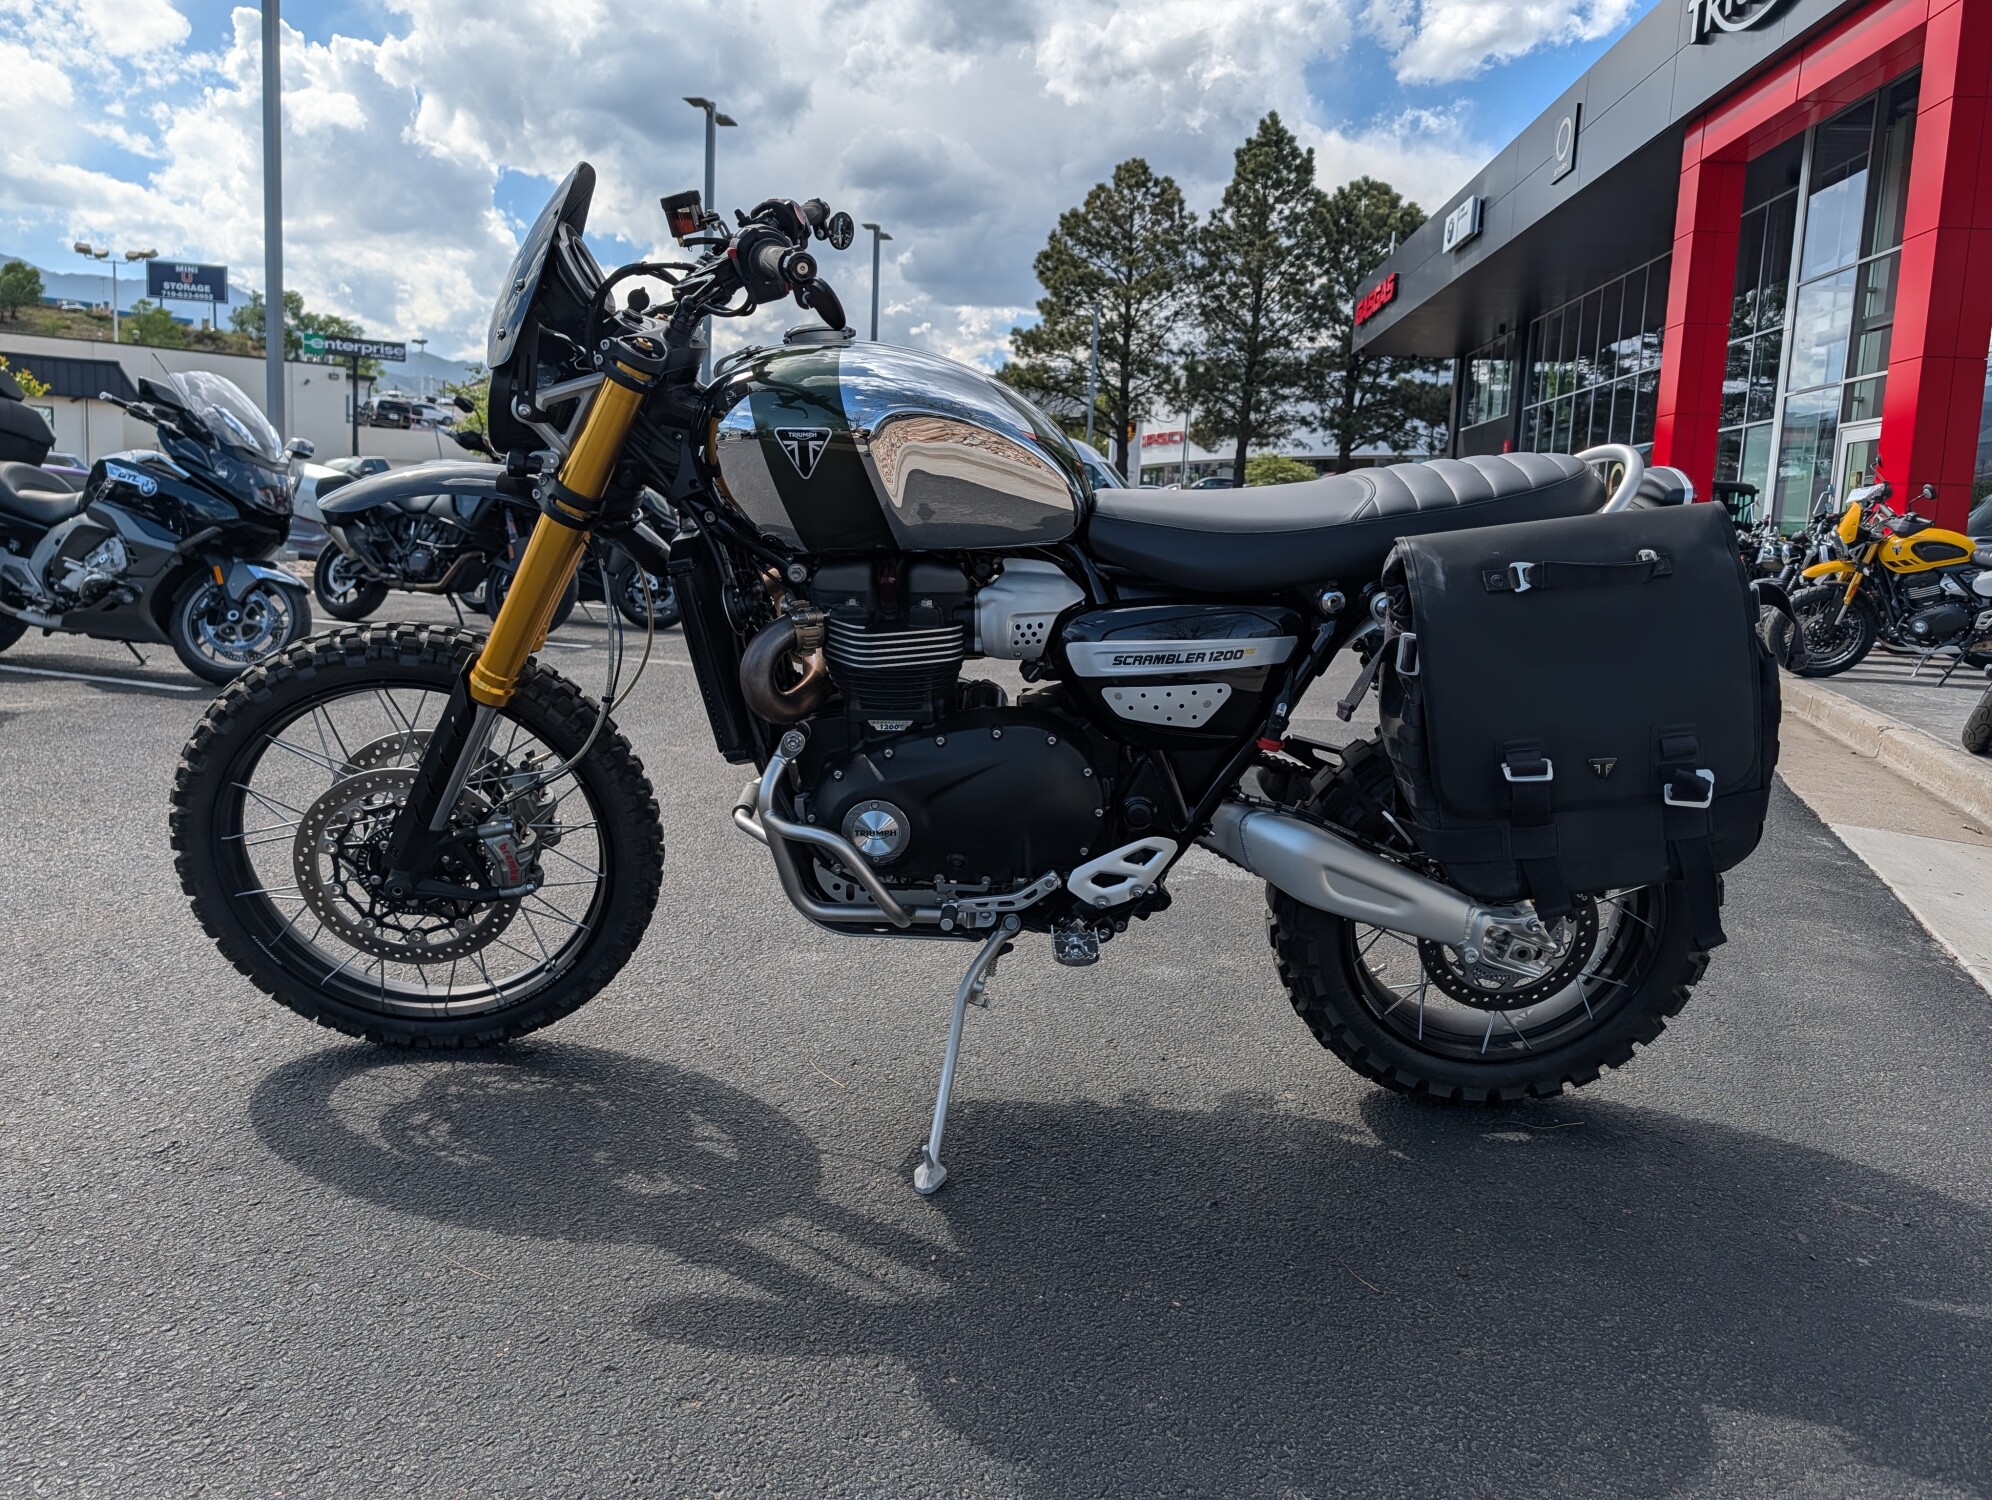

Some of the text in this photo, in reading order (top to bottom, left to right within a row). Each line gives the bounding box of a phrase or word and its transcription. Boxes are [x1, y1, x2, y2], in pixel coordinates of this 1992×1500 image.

[175, 264, 199, 274] MINI
[163, 281, 211, 293] STORAGE
[1353, 271, 1396, 326] GASGAS
[309, 337, 405, 357] enterprise
[788, 431, 818, 440] TRIUMPH
[1112, 652, 1206, 666] SCRAMBLER
[1208, 649, 1244, 662] 1200
[854, 829, 897, 840] TRIUMPH
[499, 842, 517, 881] brembo
